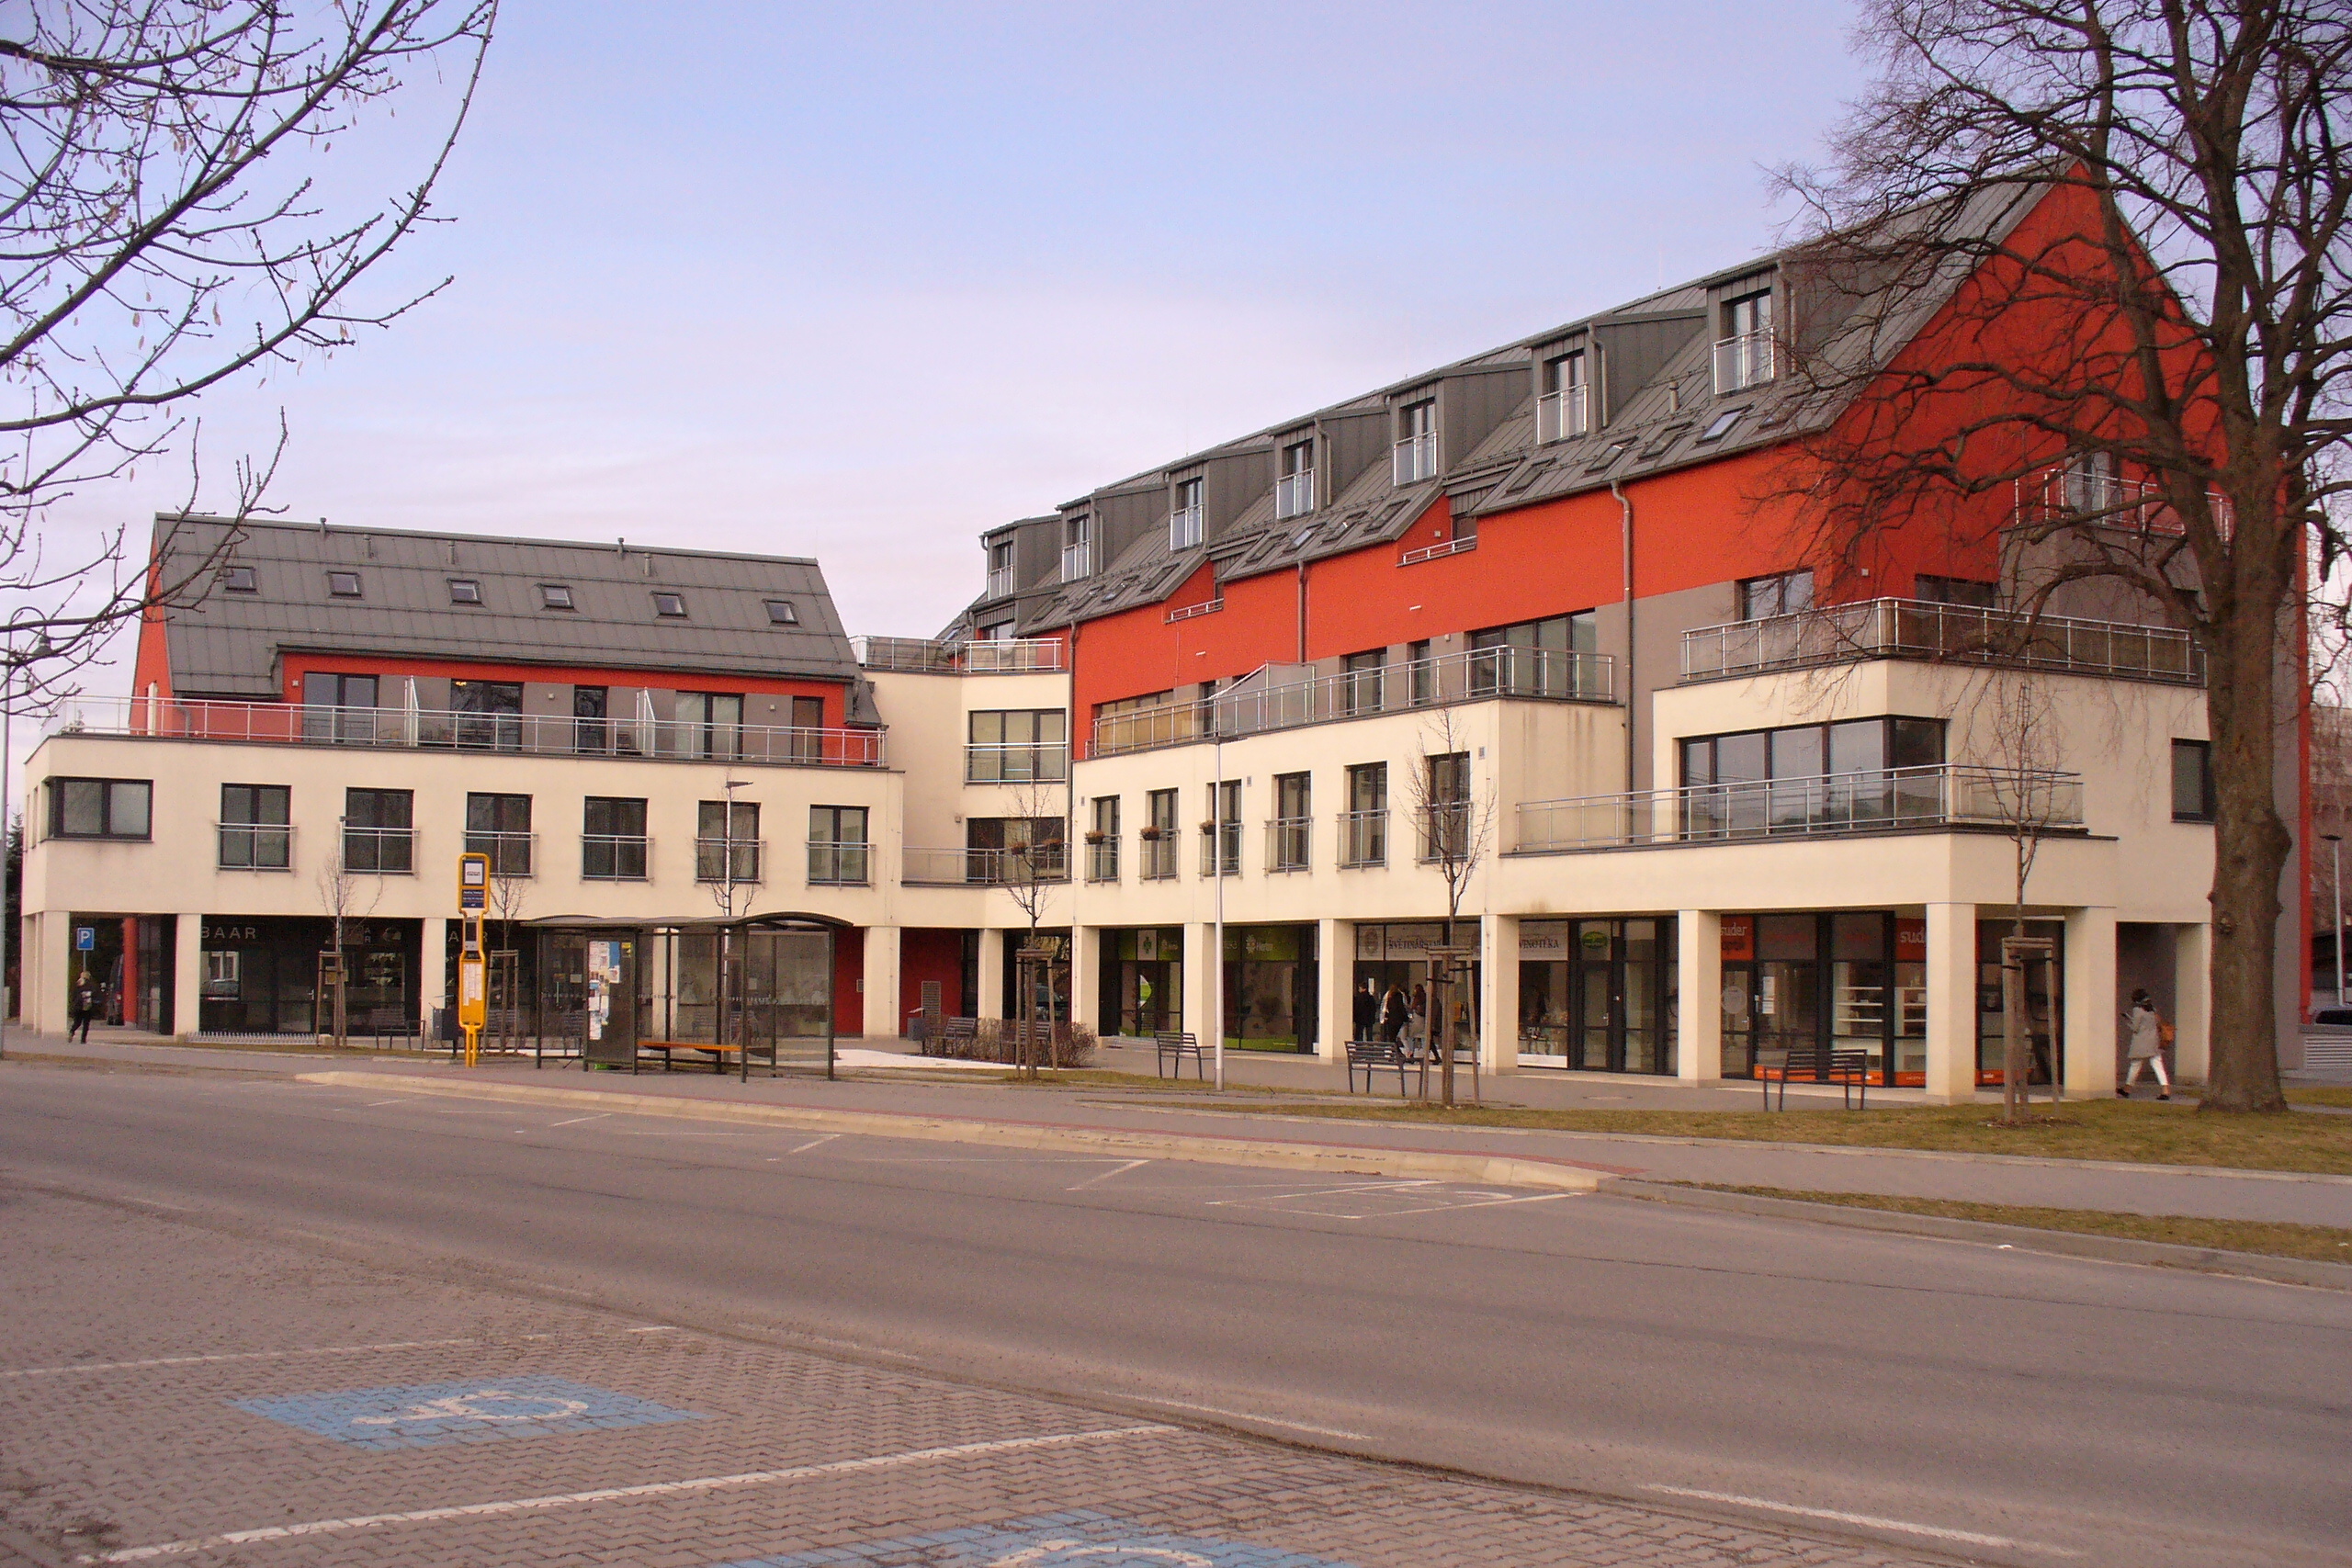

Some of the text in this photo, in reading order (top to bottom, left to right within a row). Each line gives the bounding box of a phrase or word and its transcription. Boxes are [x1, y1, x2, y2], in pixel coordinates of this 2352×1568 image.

[200, 926, 256, 940] BAAR
[1721, 921, 1747, 936] suder
[80, 930, 91, 943] P
